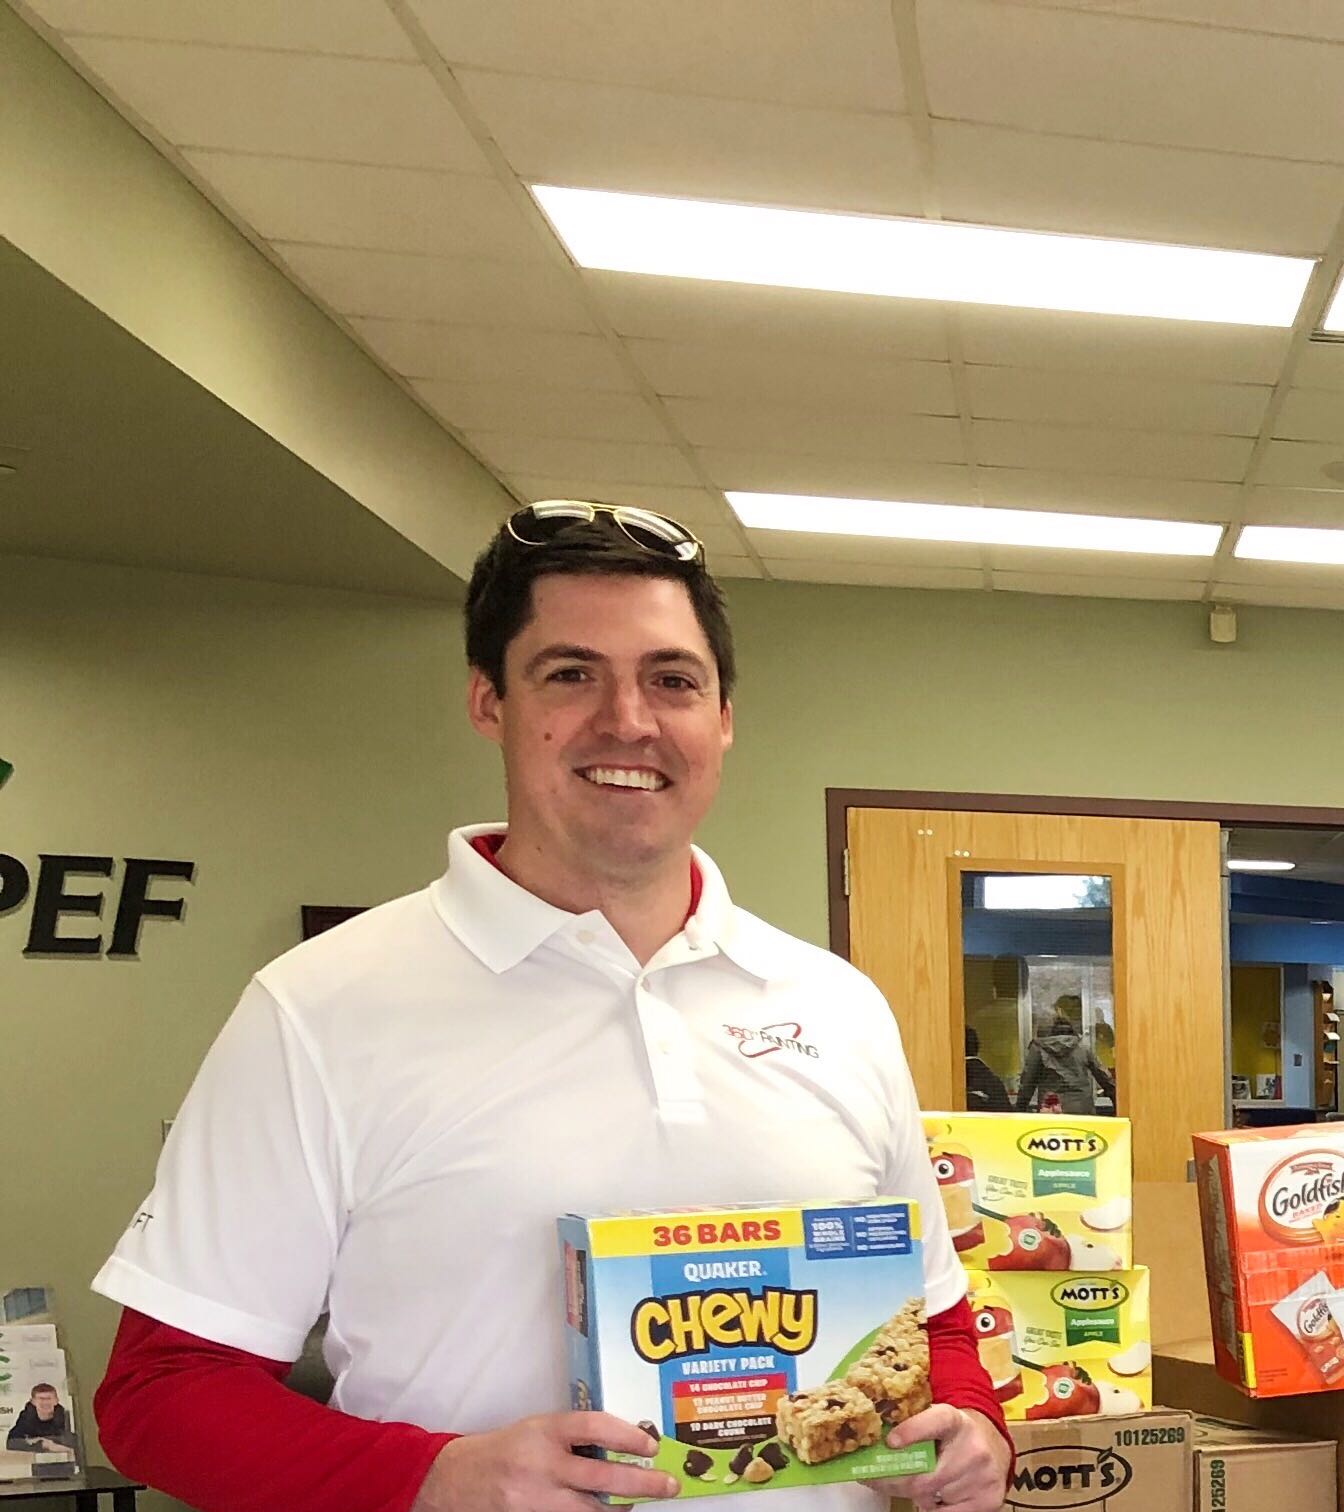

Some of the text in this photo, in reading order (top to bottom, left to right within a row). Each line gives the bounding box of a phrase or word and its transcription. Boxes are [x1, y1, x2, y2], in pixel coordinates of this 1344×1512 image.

[1027, 1134, 1097, 1152] MOTT'S
[653, 1219, 782, 1247] 36 BARS
[810, 1220, 845, 1231] 100%
[683, 1260, 765, 1283] QUAKER
[1059, 1285, 1120, 1301] MOTT'S
[681, 1355, 776, 1376] VARIETY PACK
[1114, 1427, 1185, 1448] 10125269
[1013, 1455, 1116, 1491] MOTT'S
